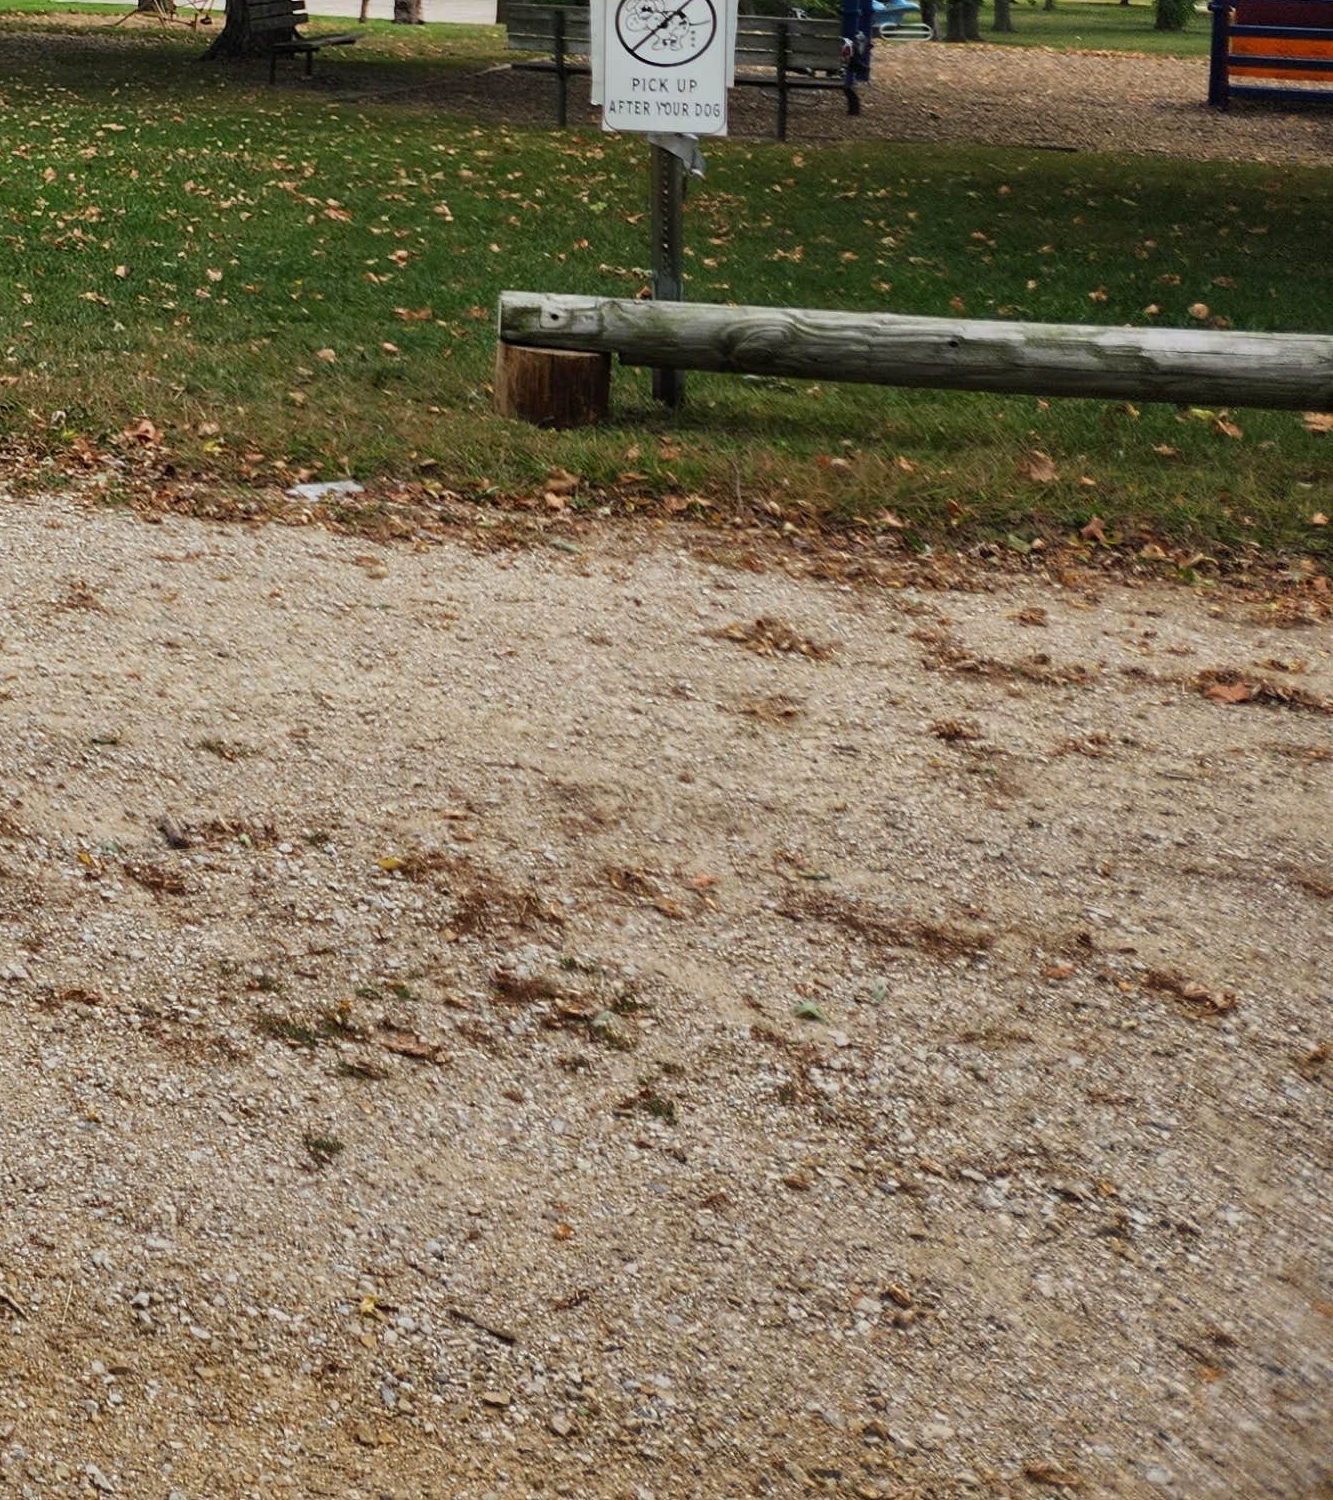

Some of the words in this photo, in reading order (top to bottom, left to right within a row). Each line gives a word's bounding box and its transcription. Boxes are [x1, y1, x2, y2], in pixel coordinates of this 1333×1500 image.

[631, 78, 670, 93] PICK
[677, 79, 698, 93] UP
[608, 100, 651, 116] AFTER
[656, 101, 689, 117] YOUR
[694, 103, 721, 118] DOG
